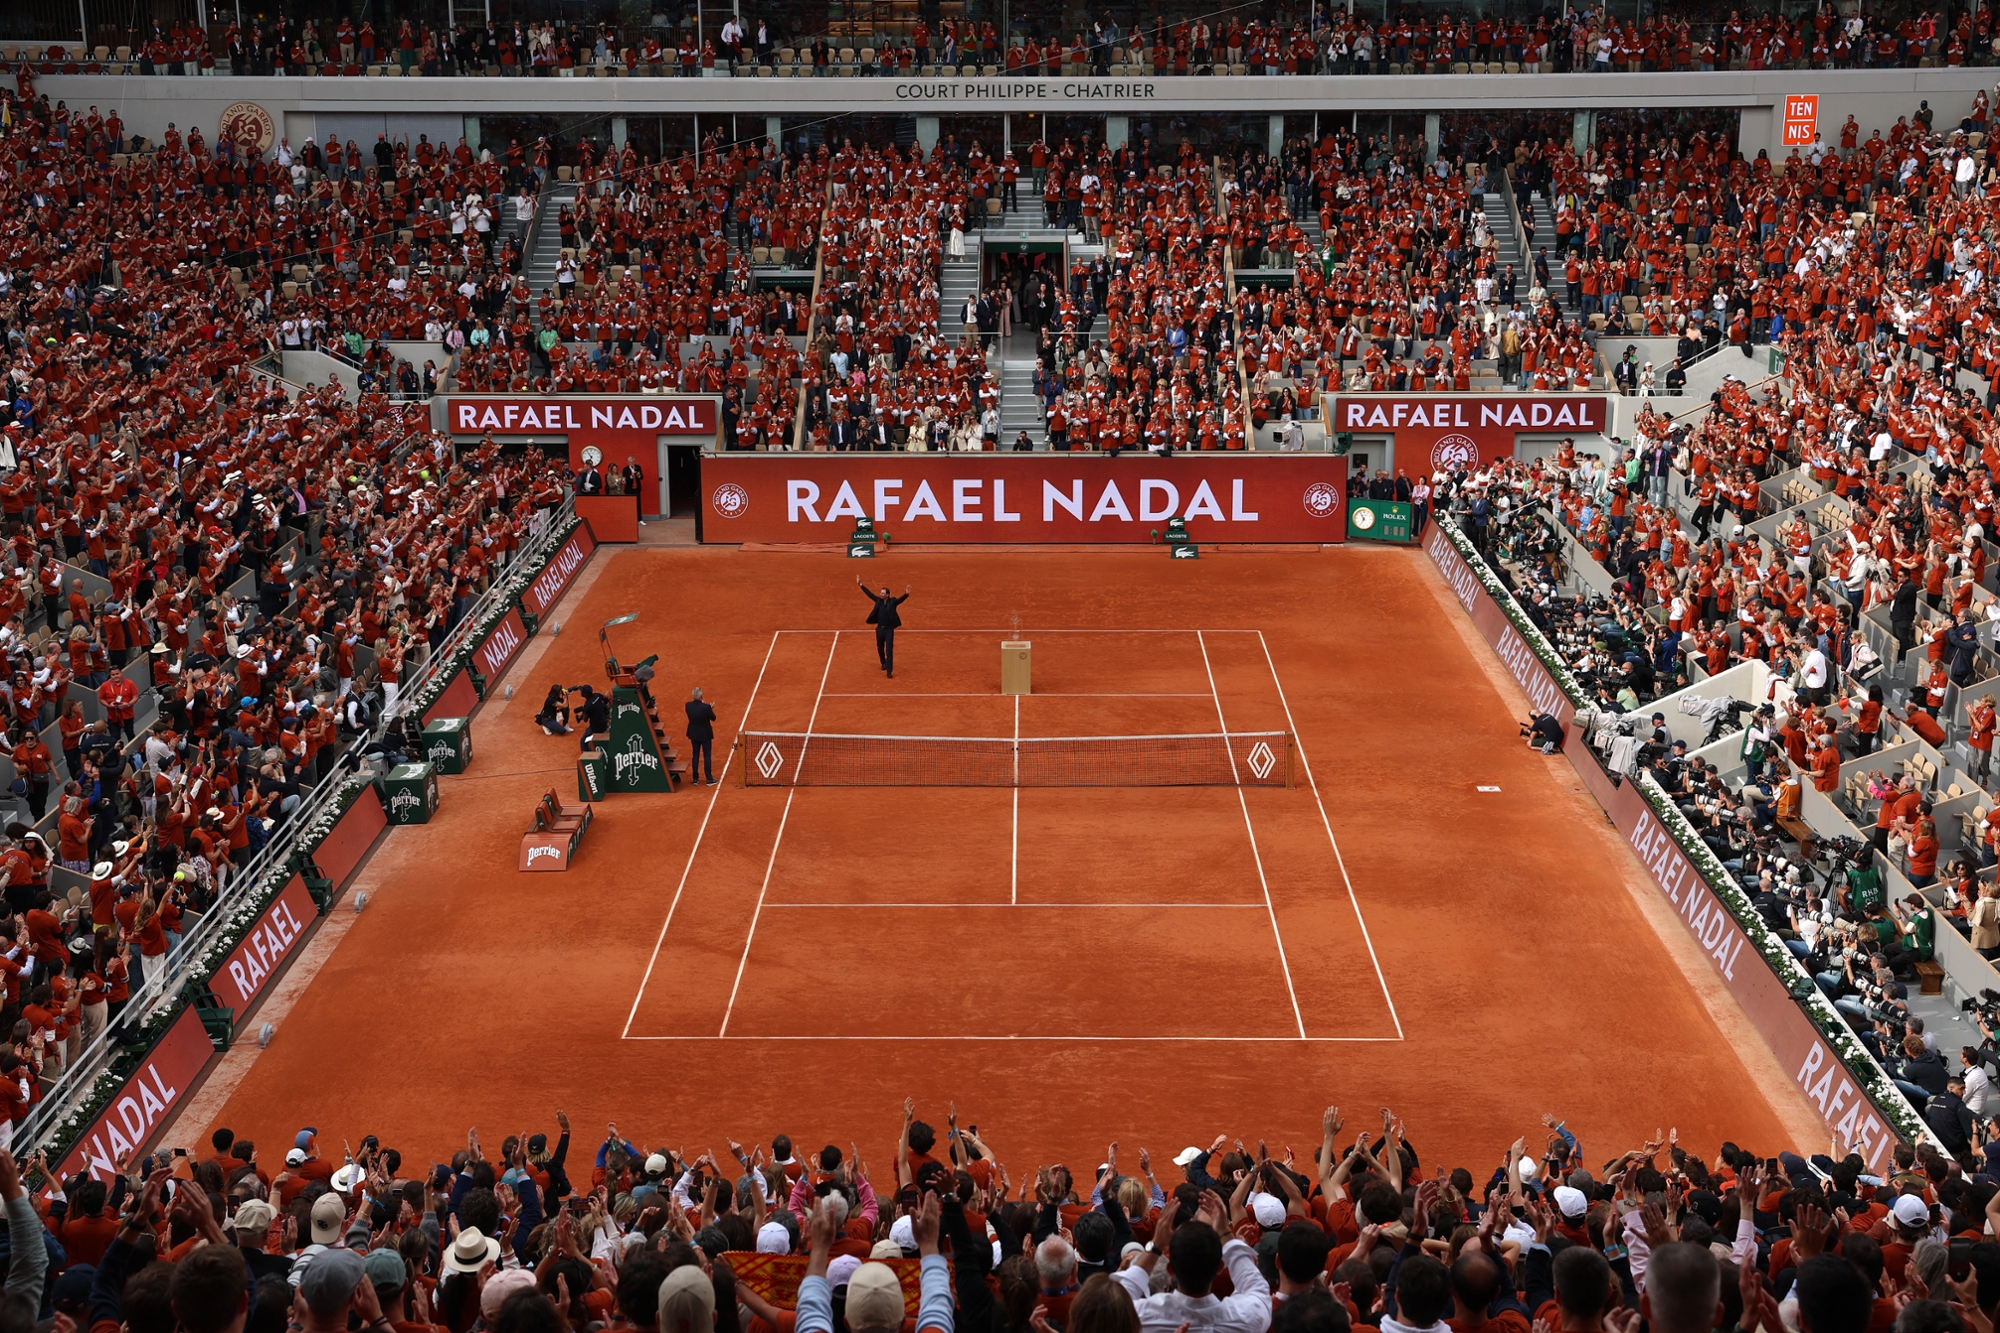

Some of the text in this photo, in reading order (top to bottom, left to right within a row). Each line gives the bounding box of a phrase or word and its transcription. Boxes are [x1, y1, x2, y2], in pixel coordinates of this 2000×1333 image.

[896, 84, 959, 98] COURT
[965, 84, 1047, 98] PHILIPPE
[1063, 83, 1155, 98] CHATRIER
[246, 105, 271, 136] GARROS
[1789, 102, 1813, 116] TEN
[1788, 124, 1810, 139] NIS
[458, 405, 704, 429] RAFAEL NADAL
[1347, 403, 1594, 427] RAFAEL NADAL
[1434, 437, 1476, 462] ROLAND GARROS
[786, 479, 1259, 522] RAFAEL NADAL
[1382, 513, 1407, 521] ROLEX
[533, 539, 584, 609] RAFAEL NADAL
[1429, 530, 1481, 612] RAFAEL NADAL
[482, 620, 519, 673] NADAL
[1496, 624, 1533, 687] RAFAEL
[584, 763, 598, 794] Wilson
[1630, 809, 1744, 982] RAFAEL NADAL
[228, 899, 303, 1002] RAFAEL
[80, 1063, 177, 1182] NADAL
